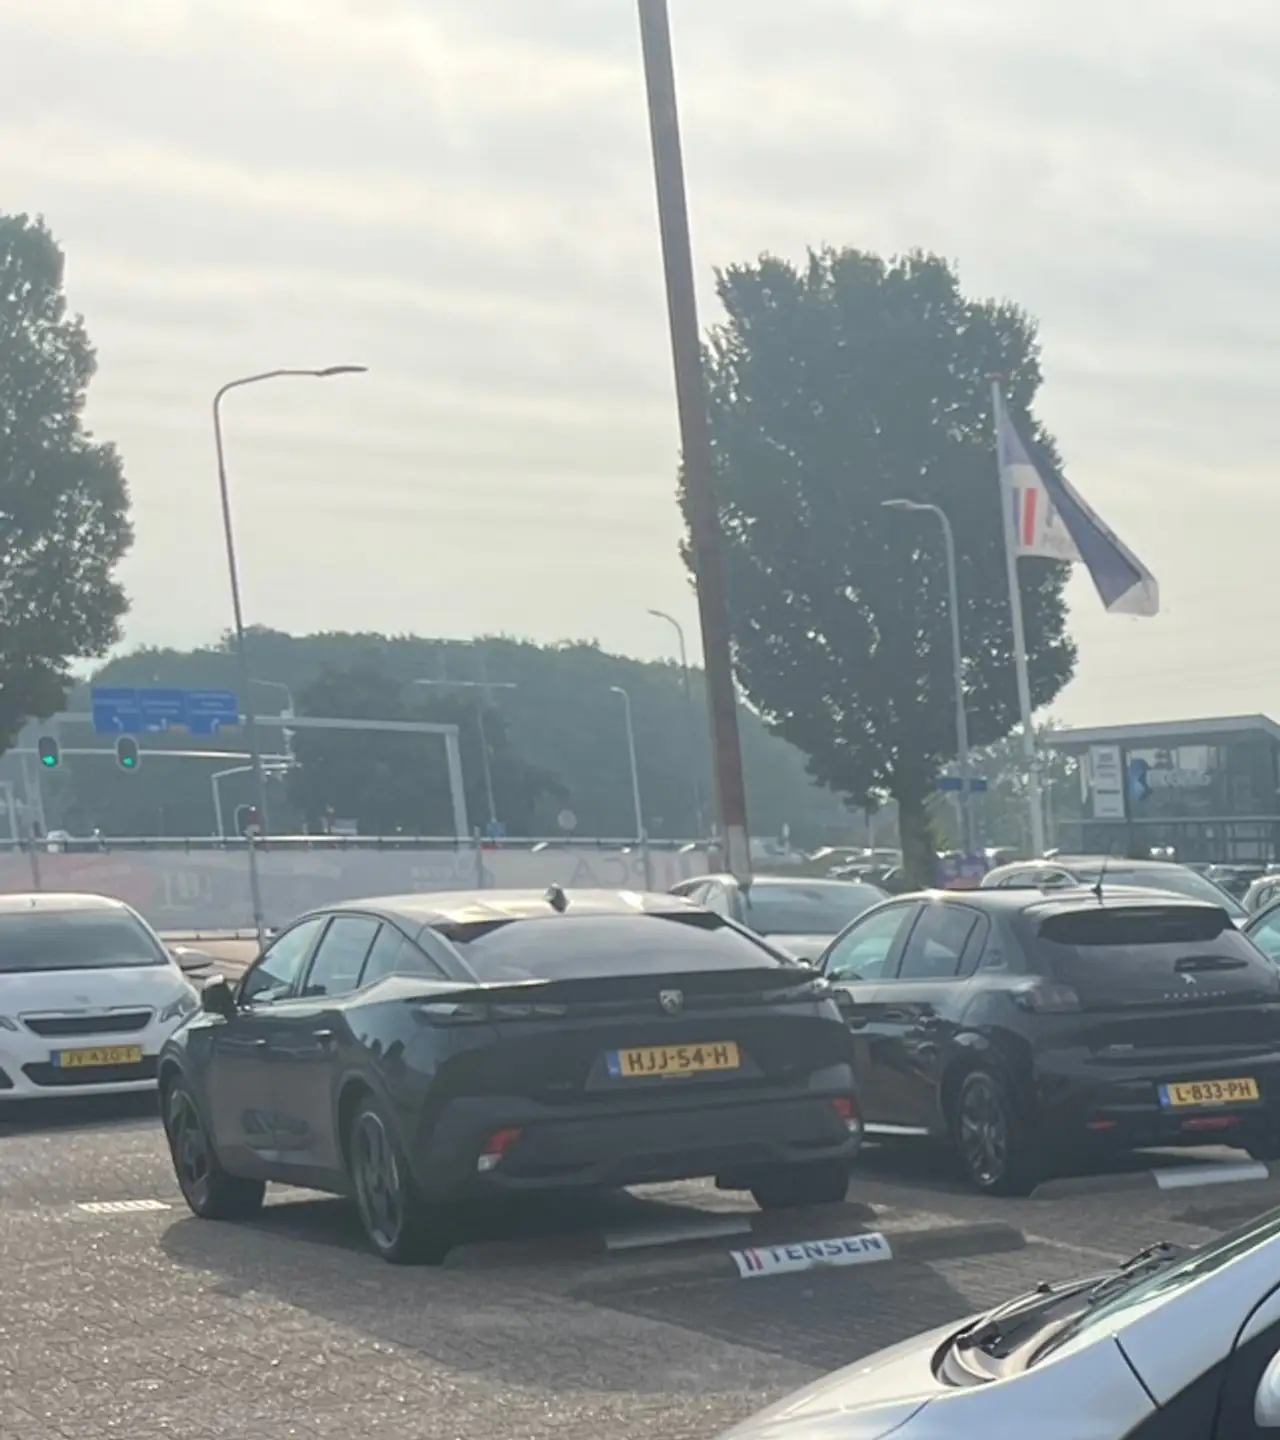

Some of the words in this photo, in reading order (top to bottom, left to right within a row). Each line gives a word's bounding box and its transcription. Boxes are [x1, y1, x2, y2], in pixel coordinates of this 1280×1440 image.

[627, 1045, 729, 1073] HJJ-54-H
[1175, 1080, 1252, 1102] L-833-PH
[770, 1236, 882, 1264] TENSEN
